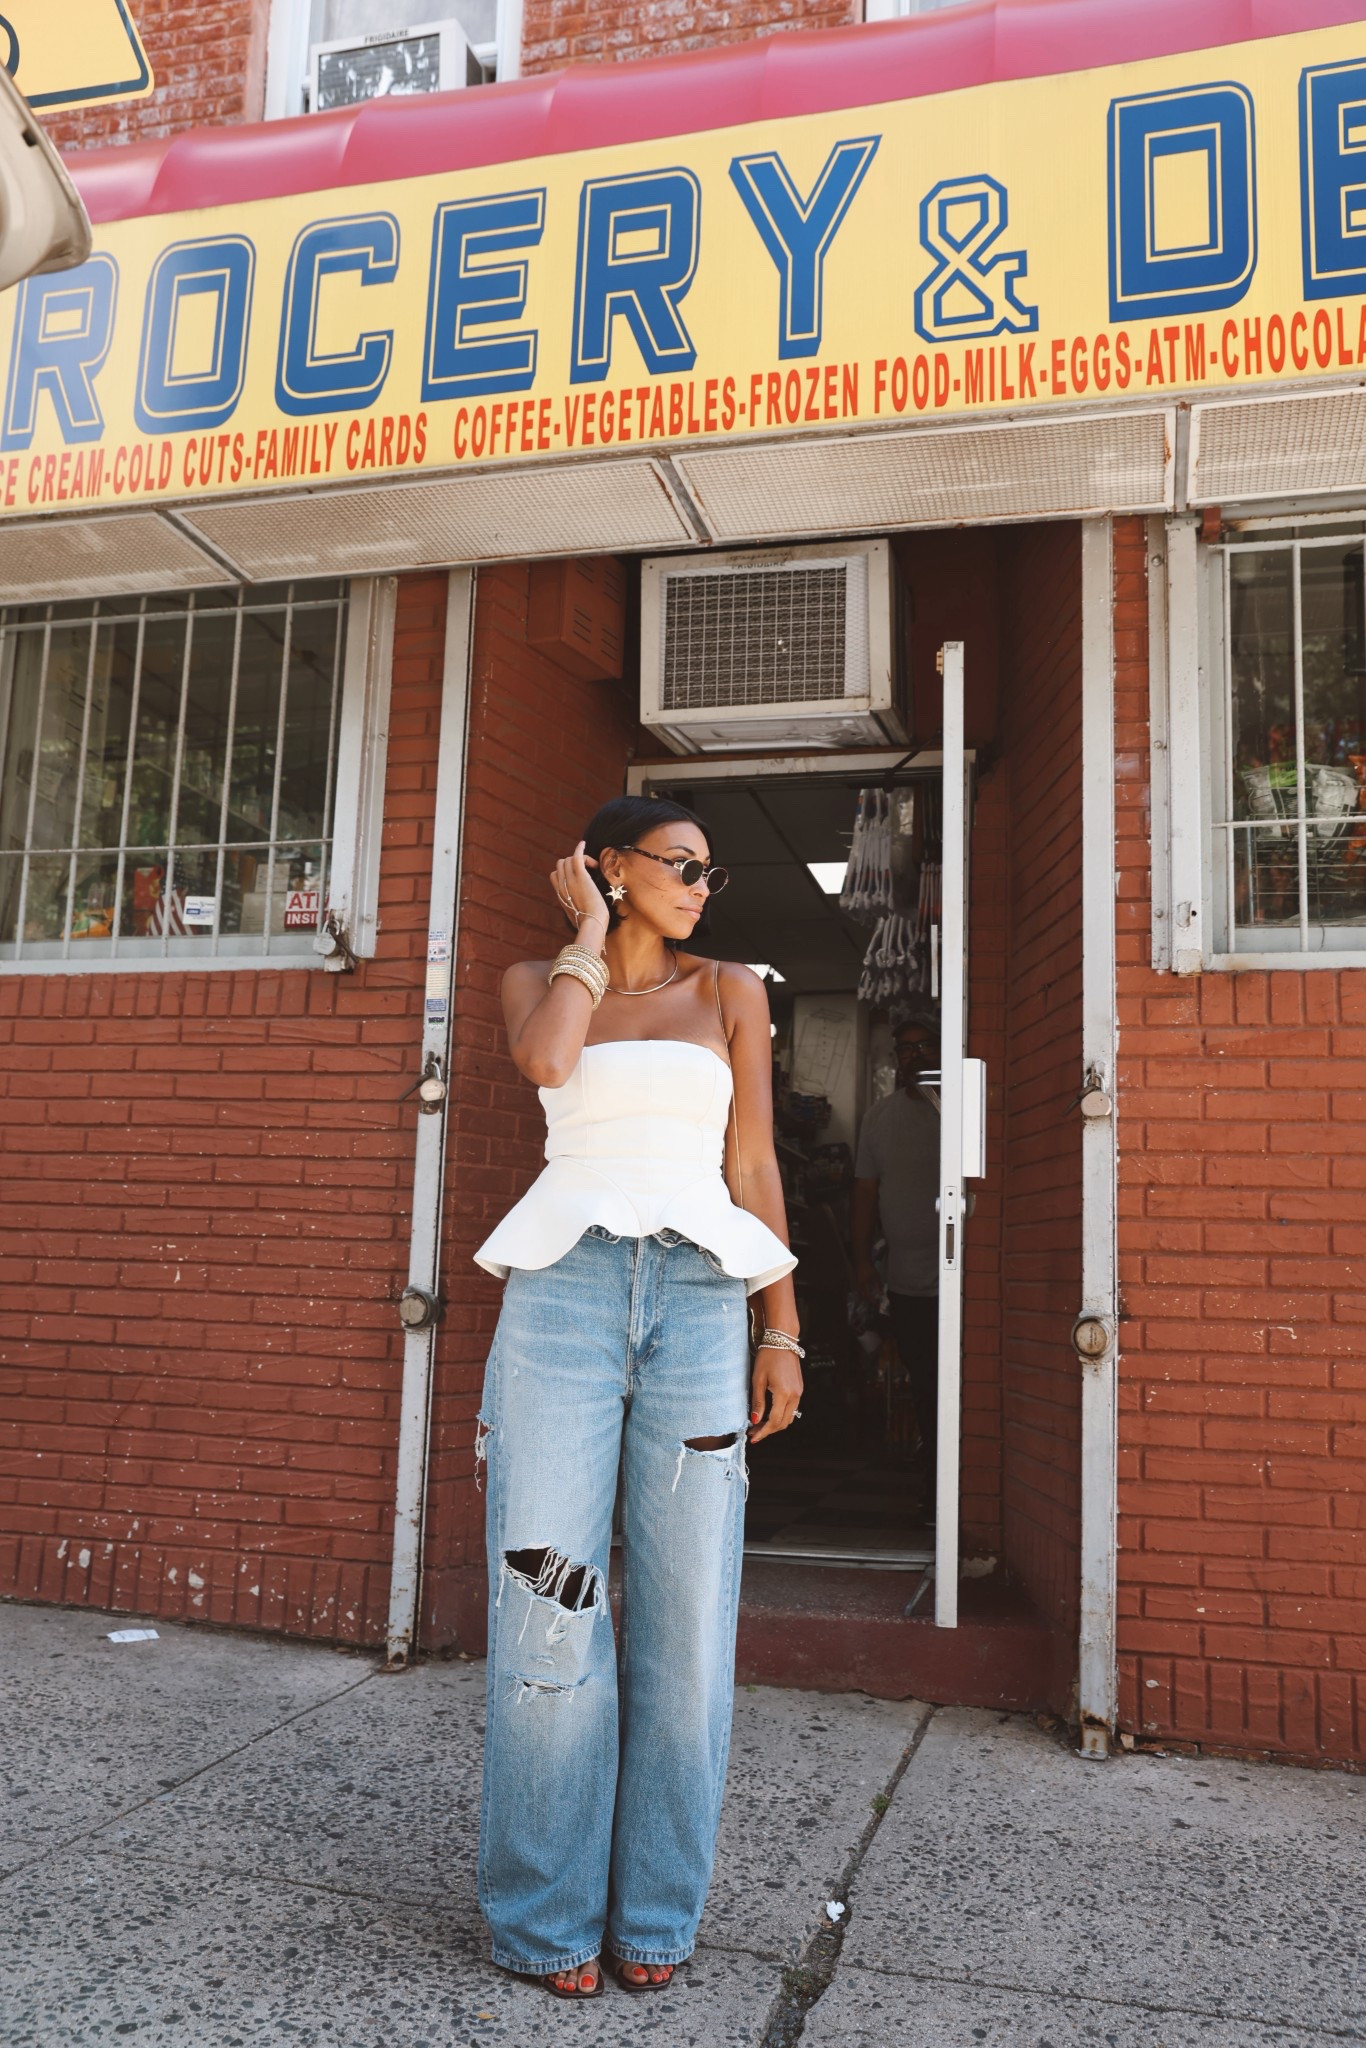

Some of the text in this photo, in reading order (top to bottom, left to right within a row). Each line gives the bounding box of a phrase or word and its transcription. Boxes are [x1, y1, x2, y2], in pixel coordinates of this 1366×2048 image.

[364, 28, 409, 43] FRIGIDAIRE
[913, 174, 1039, 343] &
[183, 420, 340, 487] CUTS-FAMILY
[345, 411, 428, 470] CARDS
[453, 362, 860, 460] COFFEE-VEGETABLES-FROZEN
